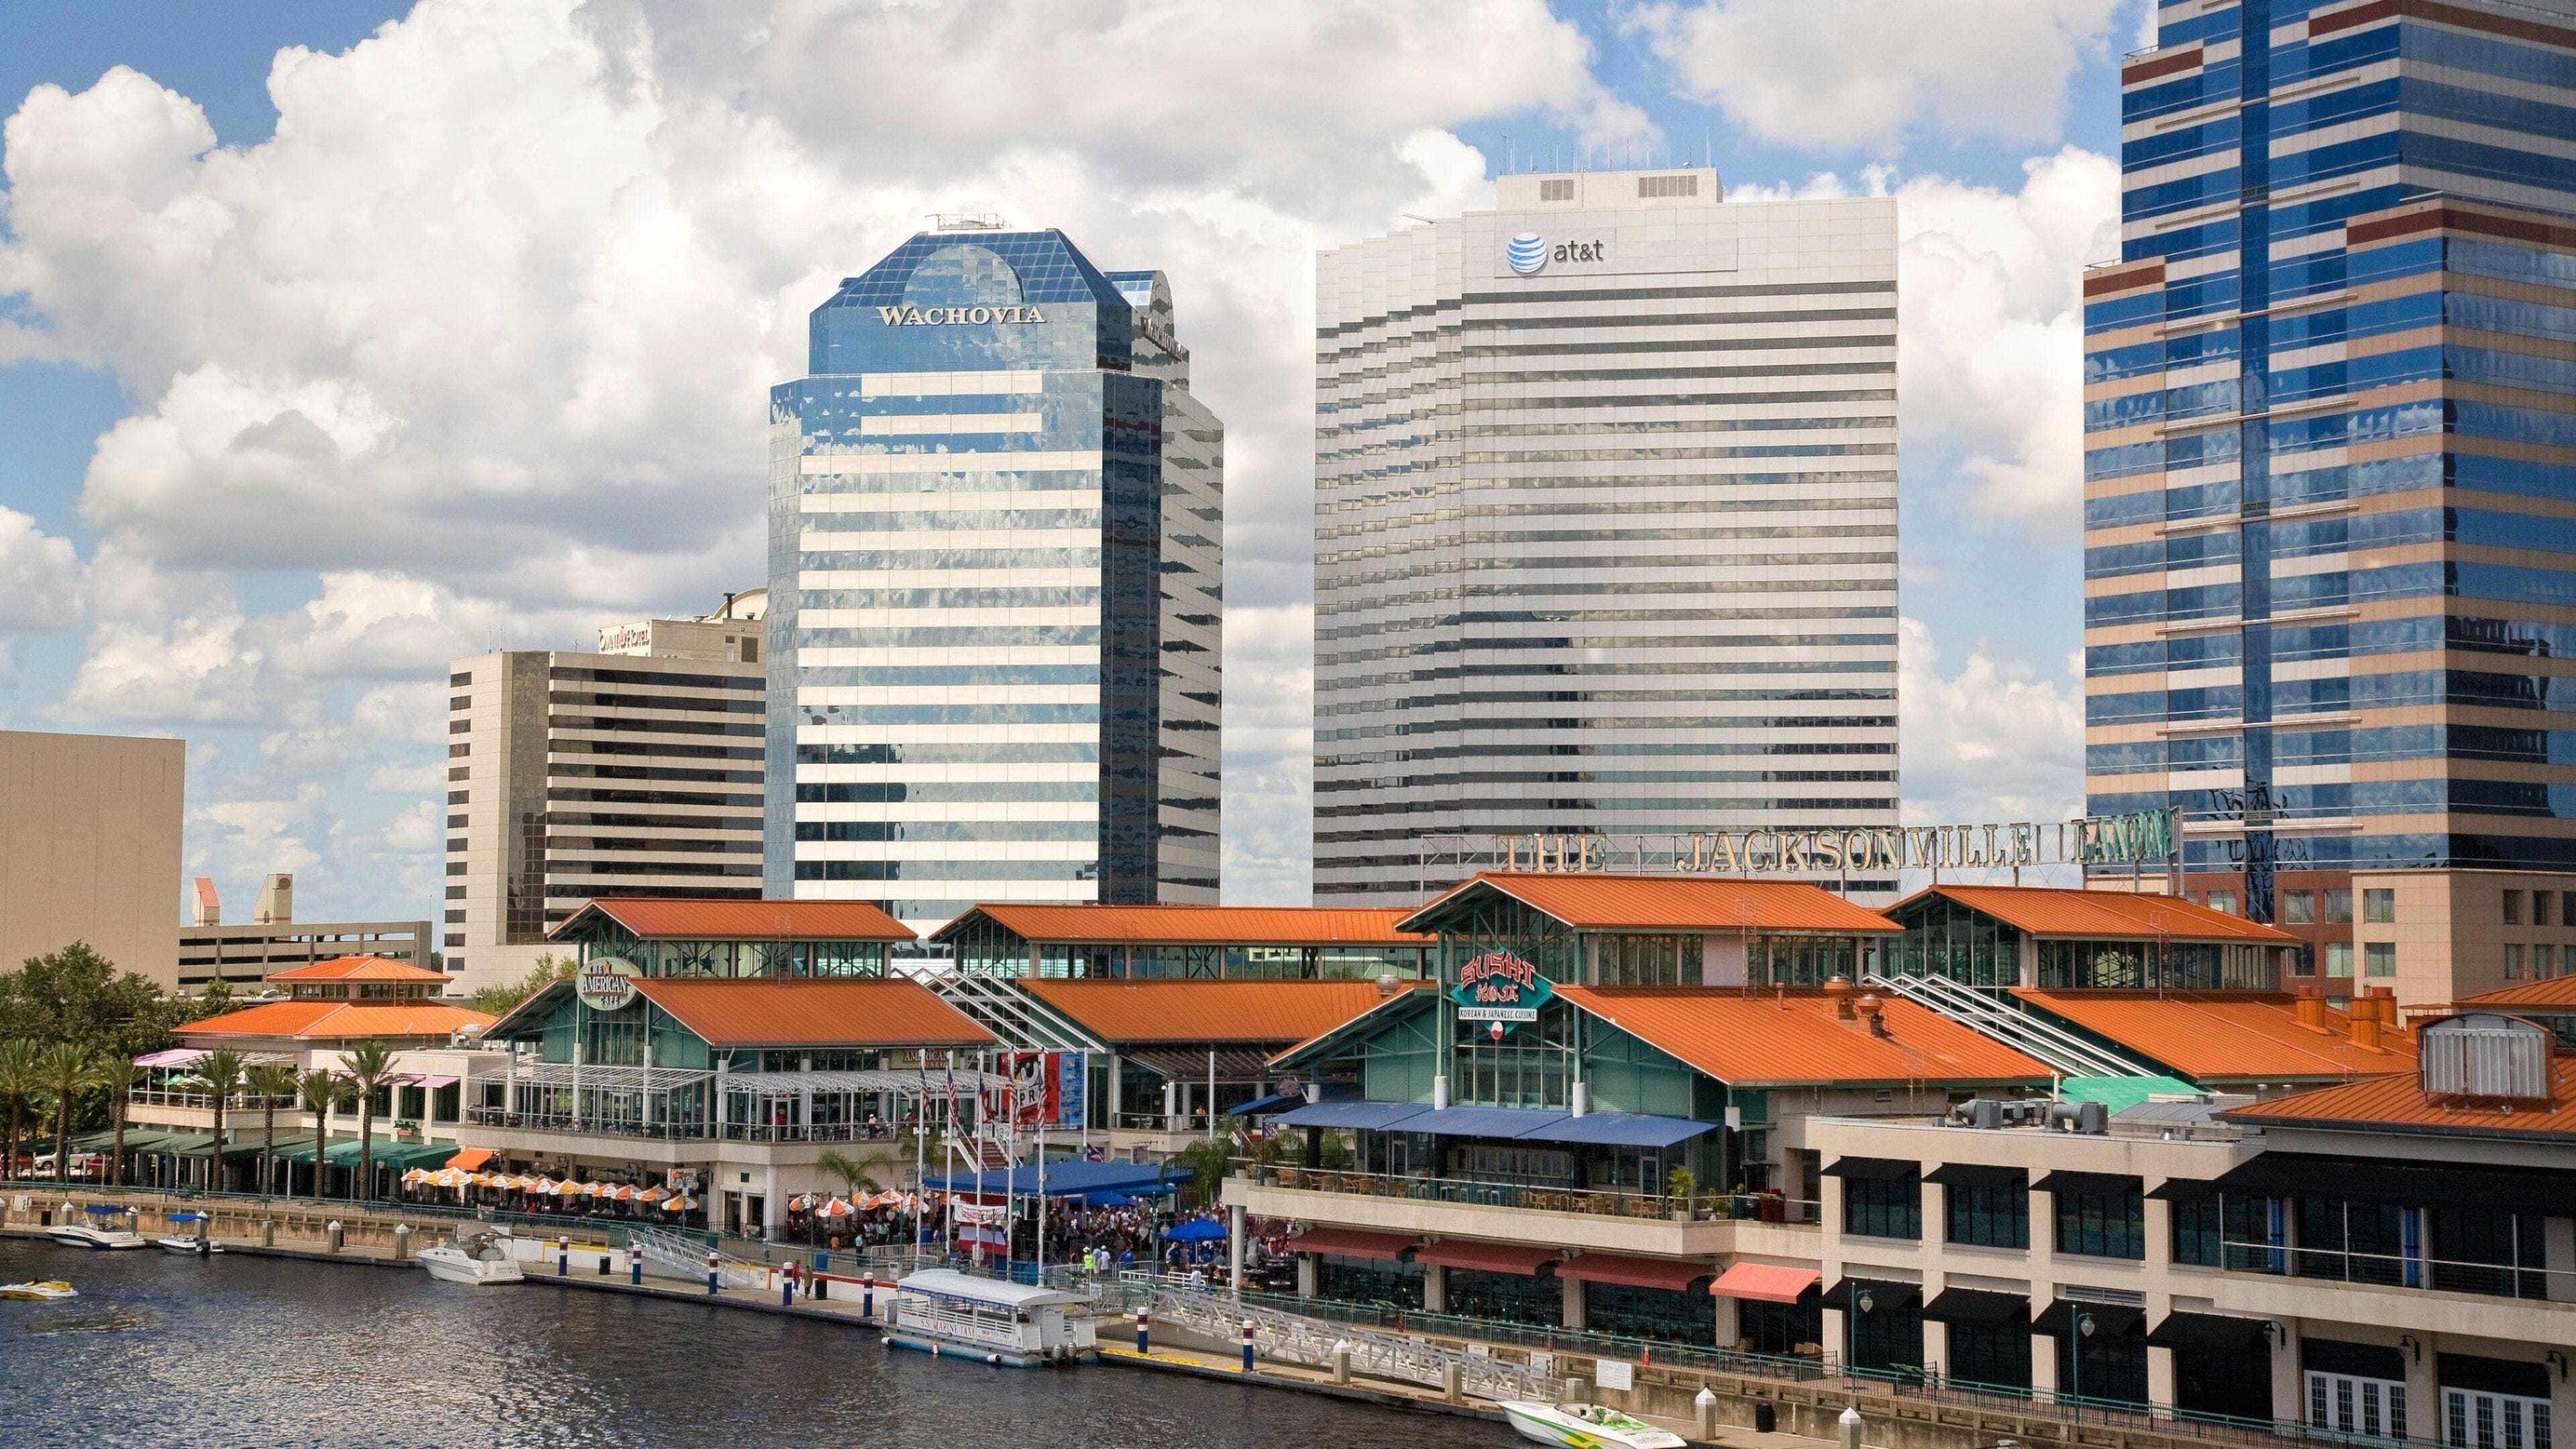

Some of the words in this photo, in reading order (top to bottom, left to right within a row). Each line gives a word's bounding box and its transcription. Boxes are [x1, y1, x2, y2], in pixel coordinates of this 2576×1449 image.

[1554, 239, 1604, 262] at&t
[876, 306, 1046, 327] WACHOVIA
[1497, 833, 1607, 873] THE
[1676, 822, 2031, 873] JACKSONVILLE
[1460, 951, 1536, 991] SUSHI
[583, 976, 627, 993] AMERICAN
[1475, 983, 1519, 1002] KOJA
[1460, 1009, 1481, 1018] KOREAN
[1483, 1009, 1487, 1018] &
[1488, 1009, 1514, 1019] JAPANESE
[1515, 1010, 1536, 1020] CUISINE
